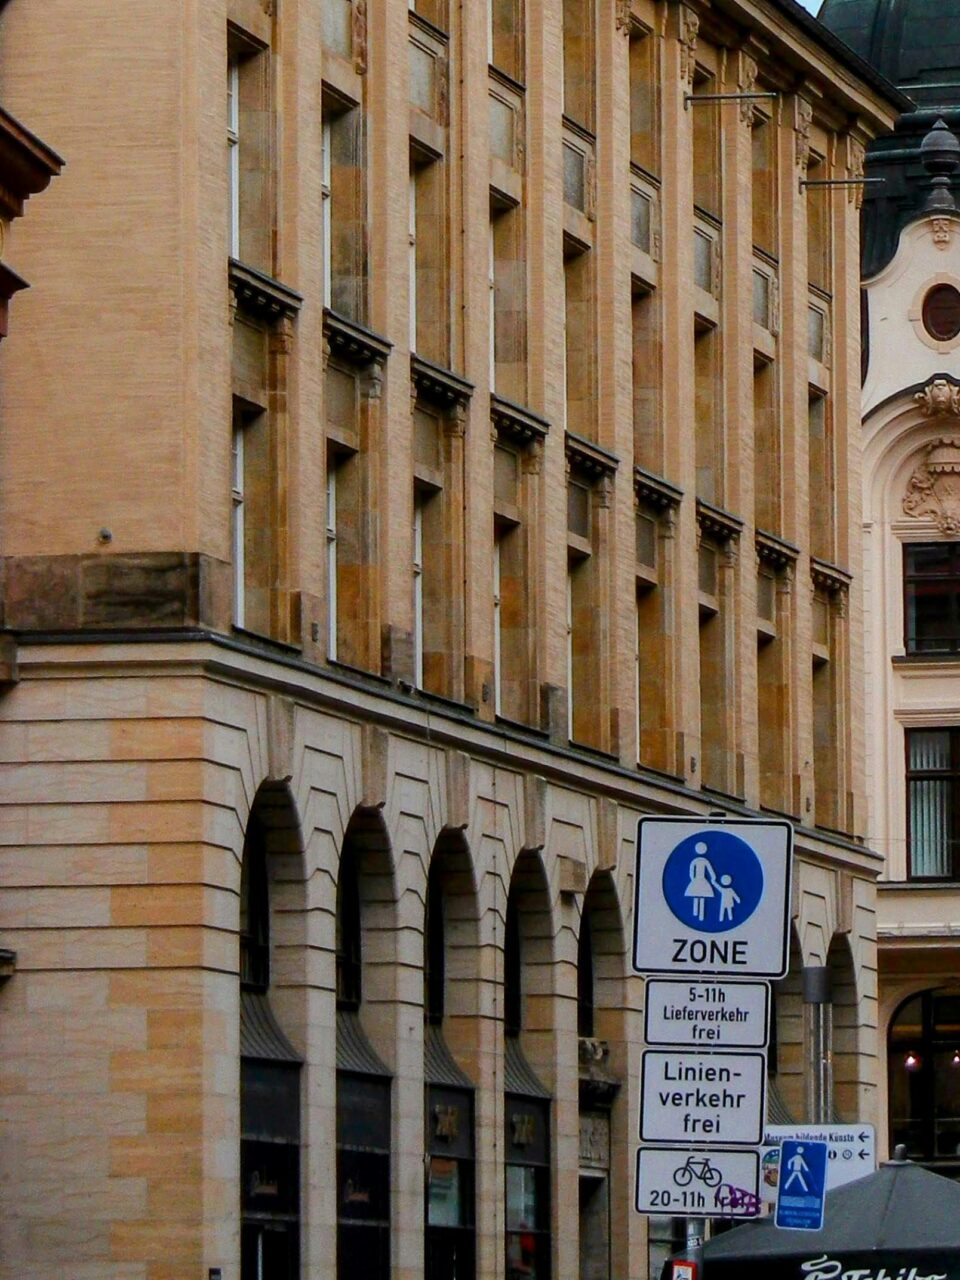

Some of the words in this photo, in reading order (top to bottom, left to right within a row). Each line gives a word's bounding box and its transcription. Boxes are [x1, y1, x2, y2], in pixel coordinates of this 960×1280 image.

[671, 938, 748, 965] ZONE
[688, 986, 726, 1003] 5-11h
[663, 1005, 750, 1023] Lieferverkehr
[692, 1024, 721, 1040] frei
[664, 1060, 742, 1082] Linien-
[659, 1087, 746, 1108] verkehr
[683, 1113, 720, 1133] frei
[828, 1132, 854, 1142] Künste
[649, 1190, 705, 1208] 20-11h
